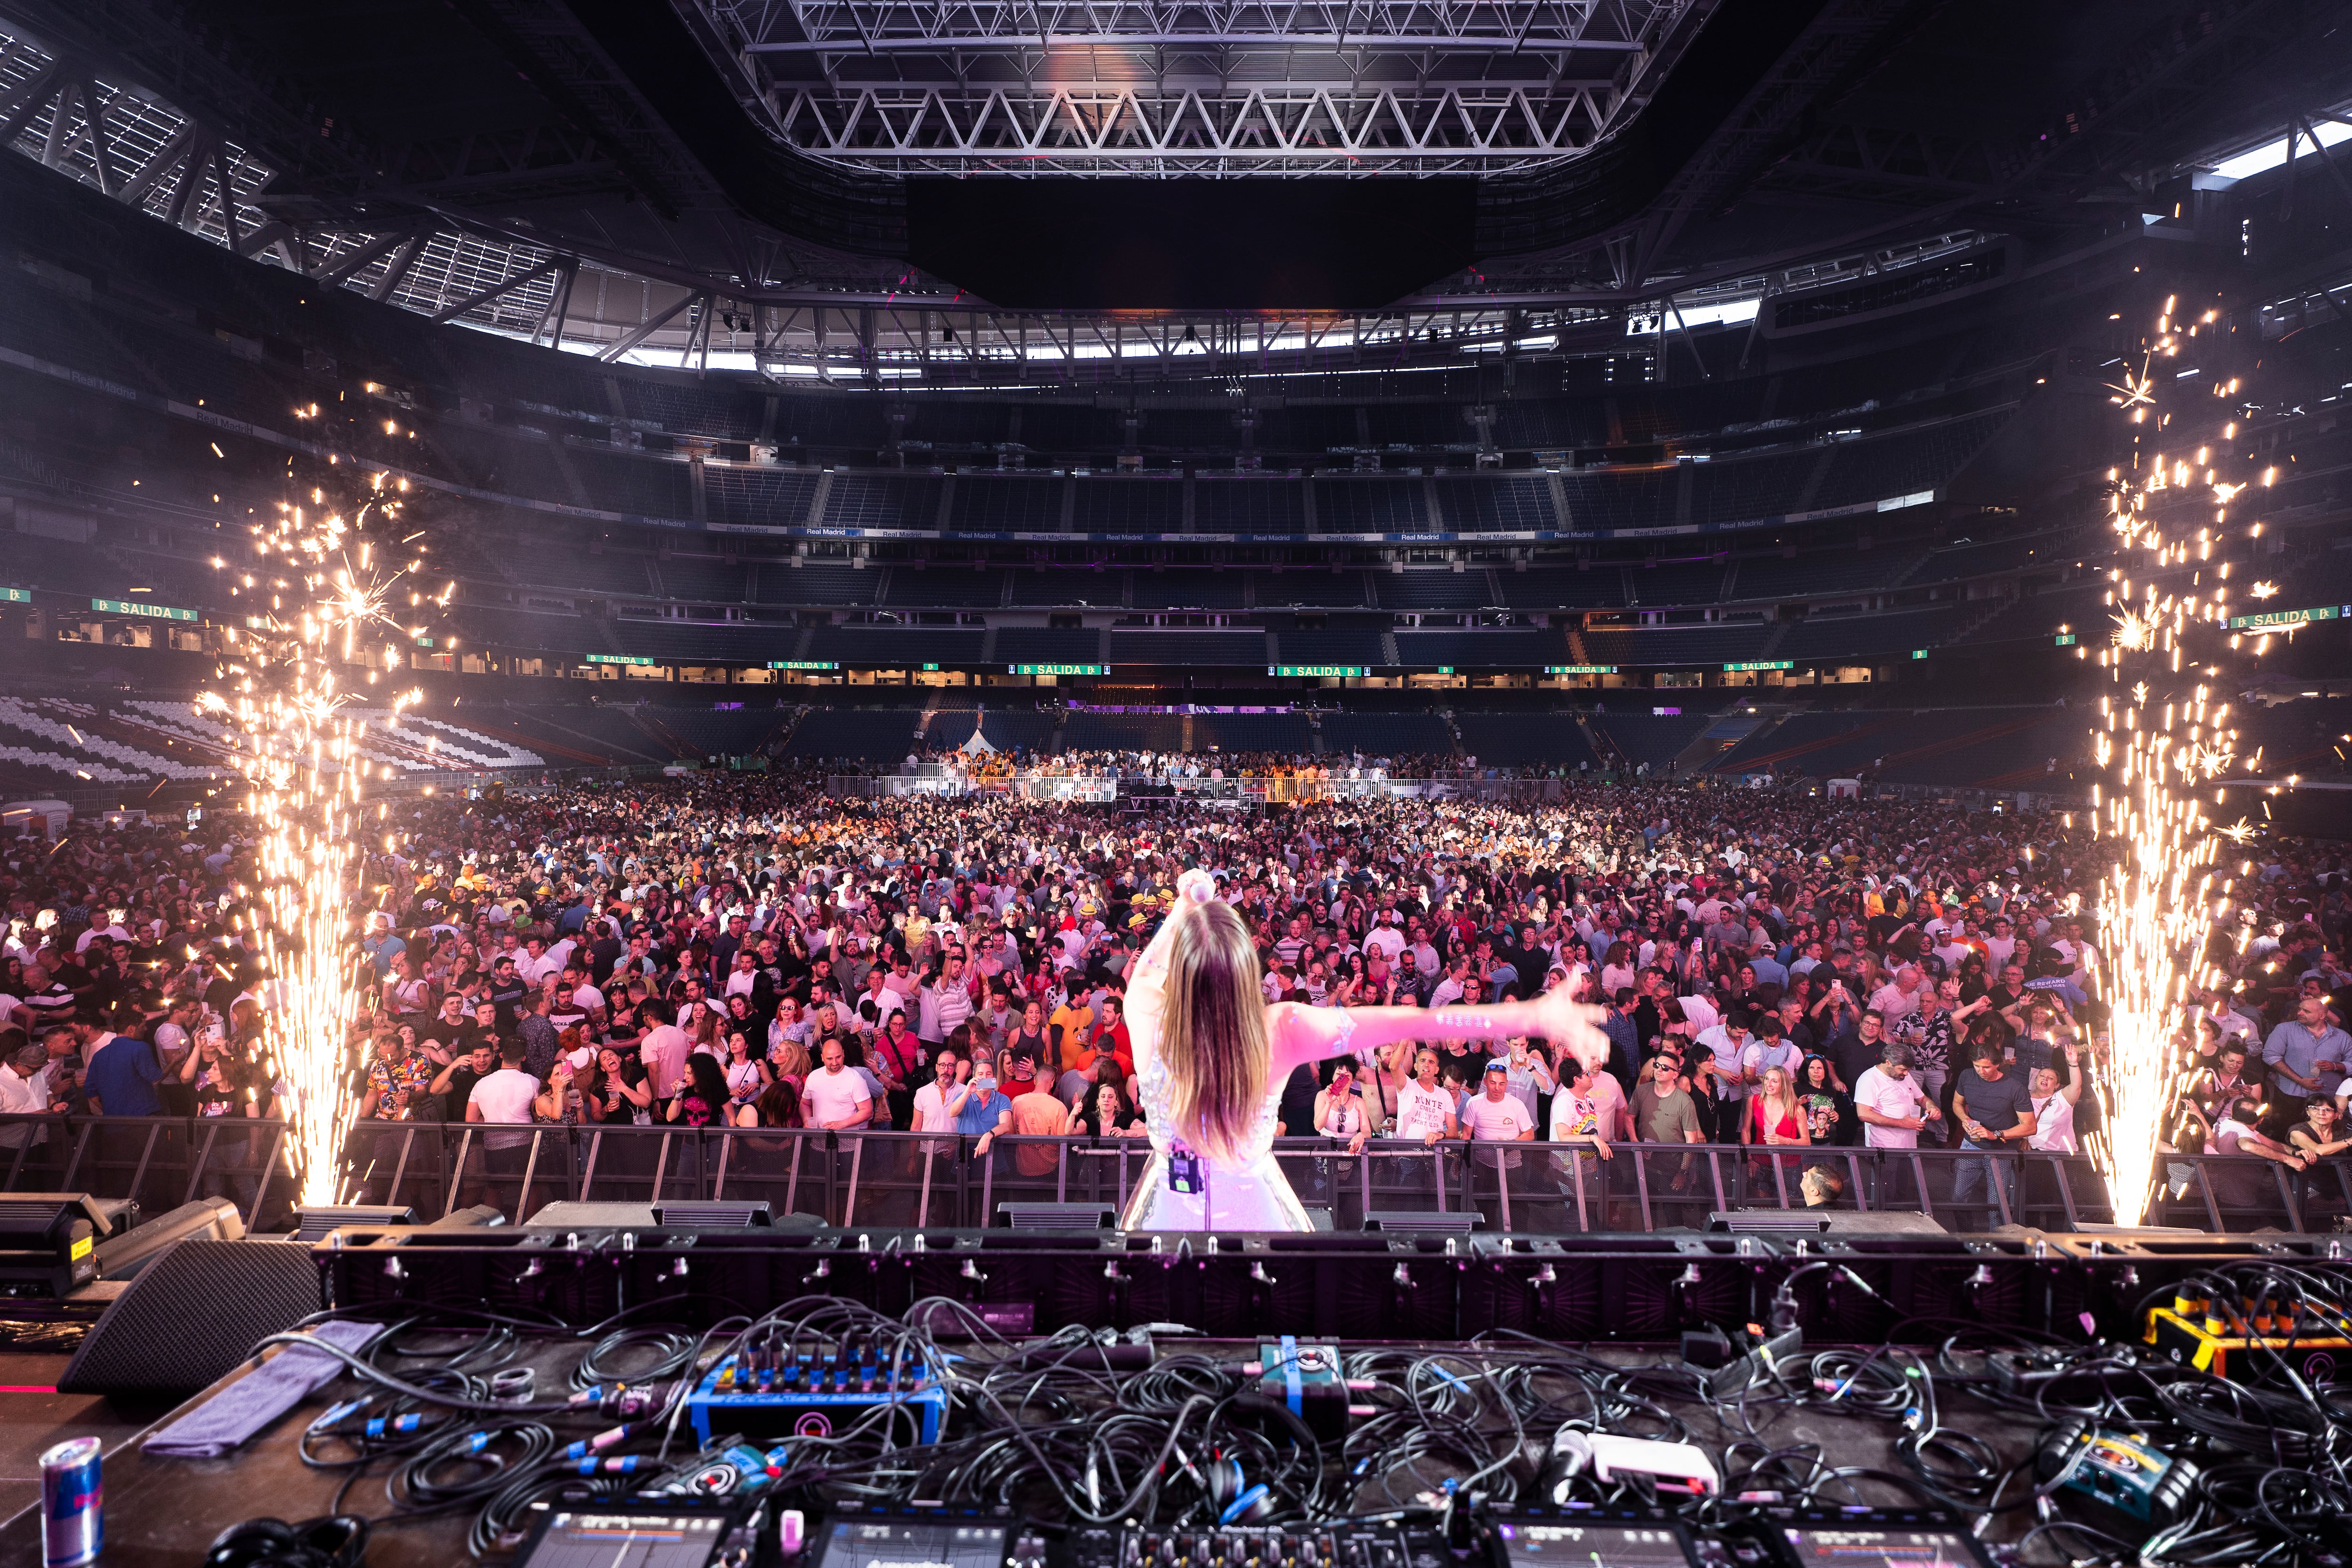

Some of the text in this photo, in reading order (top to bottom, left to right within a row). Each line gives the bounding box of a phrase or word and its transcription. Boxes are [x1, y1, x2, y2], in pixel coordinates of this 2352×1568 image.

[72, 371, 135, 399] Real Madrid
[197, 412, 253, 435] Real Madrid
[301, 441, 316, 453] Real
[388, 469, 429, 485] Real Madrid
[488, 493, 511, 502] Madrid
[1827, 508, 1853, 517] Madrid
[120, 603, 172, 618] SALIDA
[2255, 609, 2311, 626] SALIDA
[1038, 665, 1081, 674] SALIDA
[1297, 667, 1341, 676] SALIDA
[1415, 1096, 1442, 1109] MONTE
[1411, 1117, 1426, 1126] YACHT
